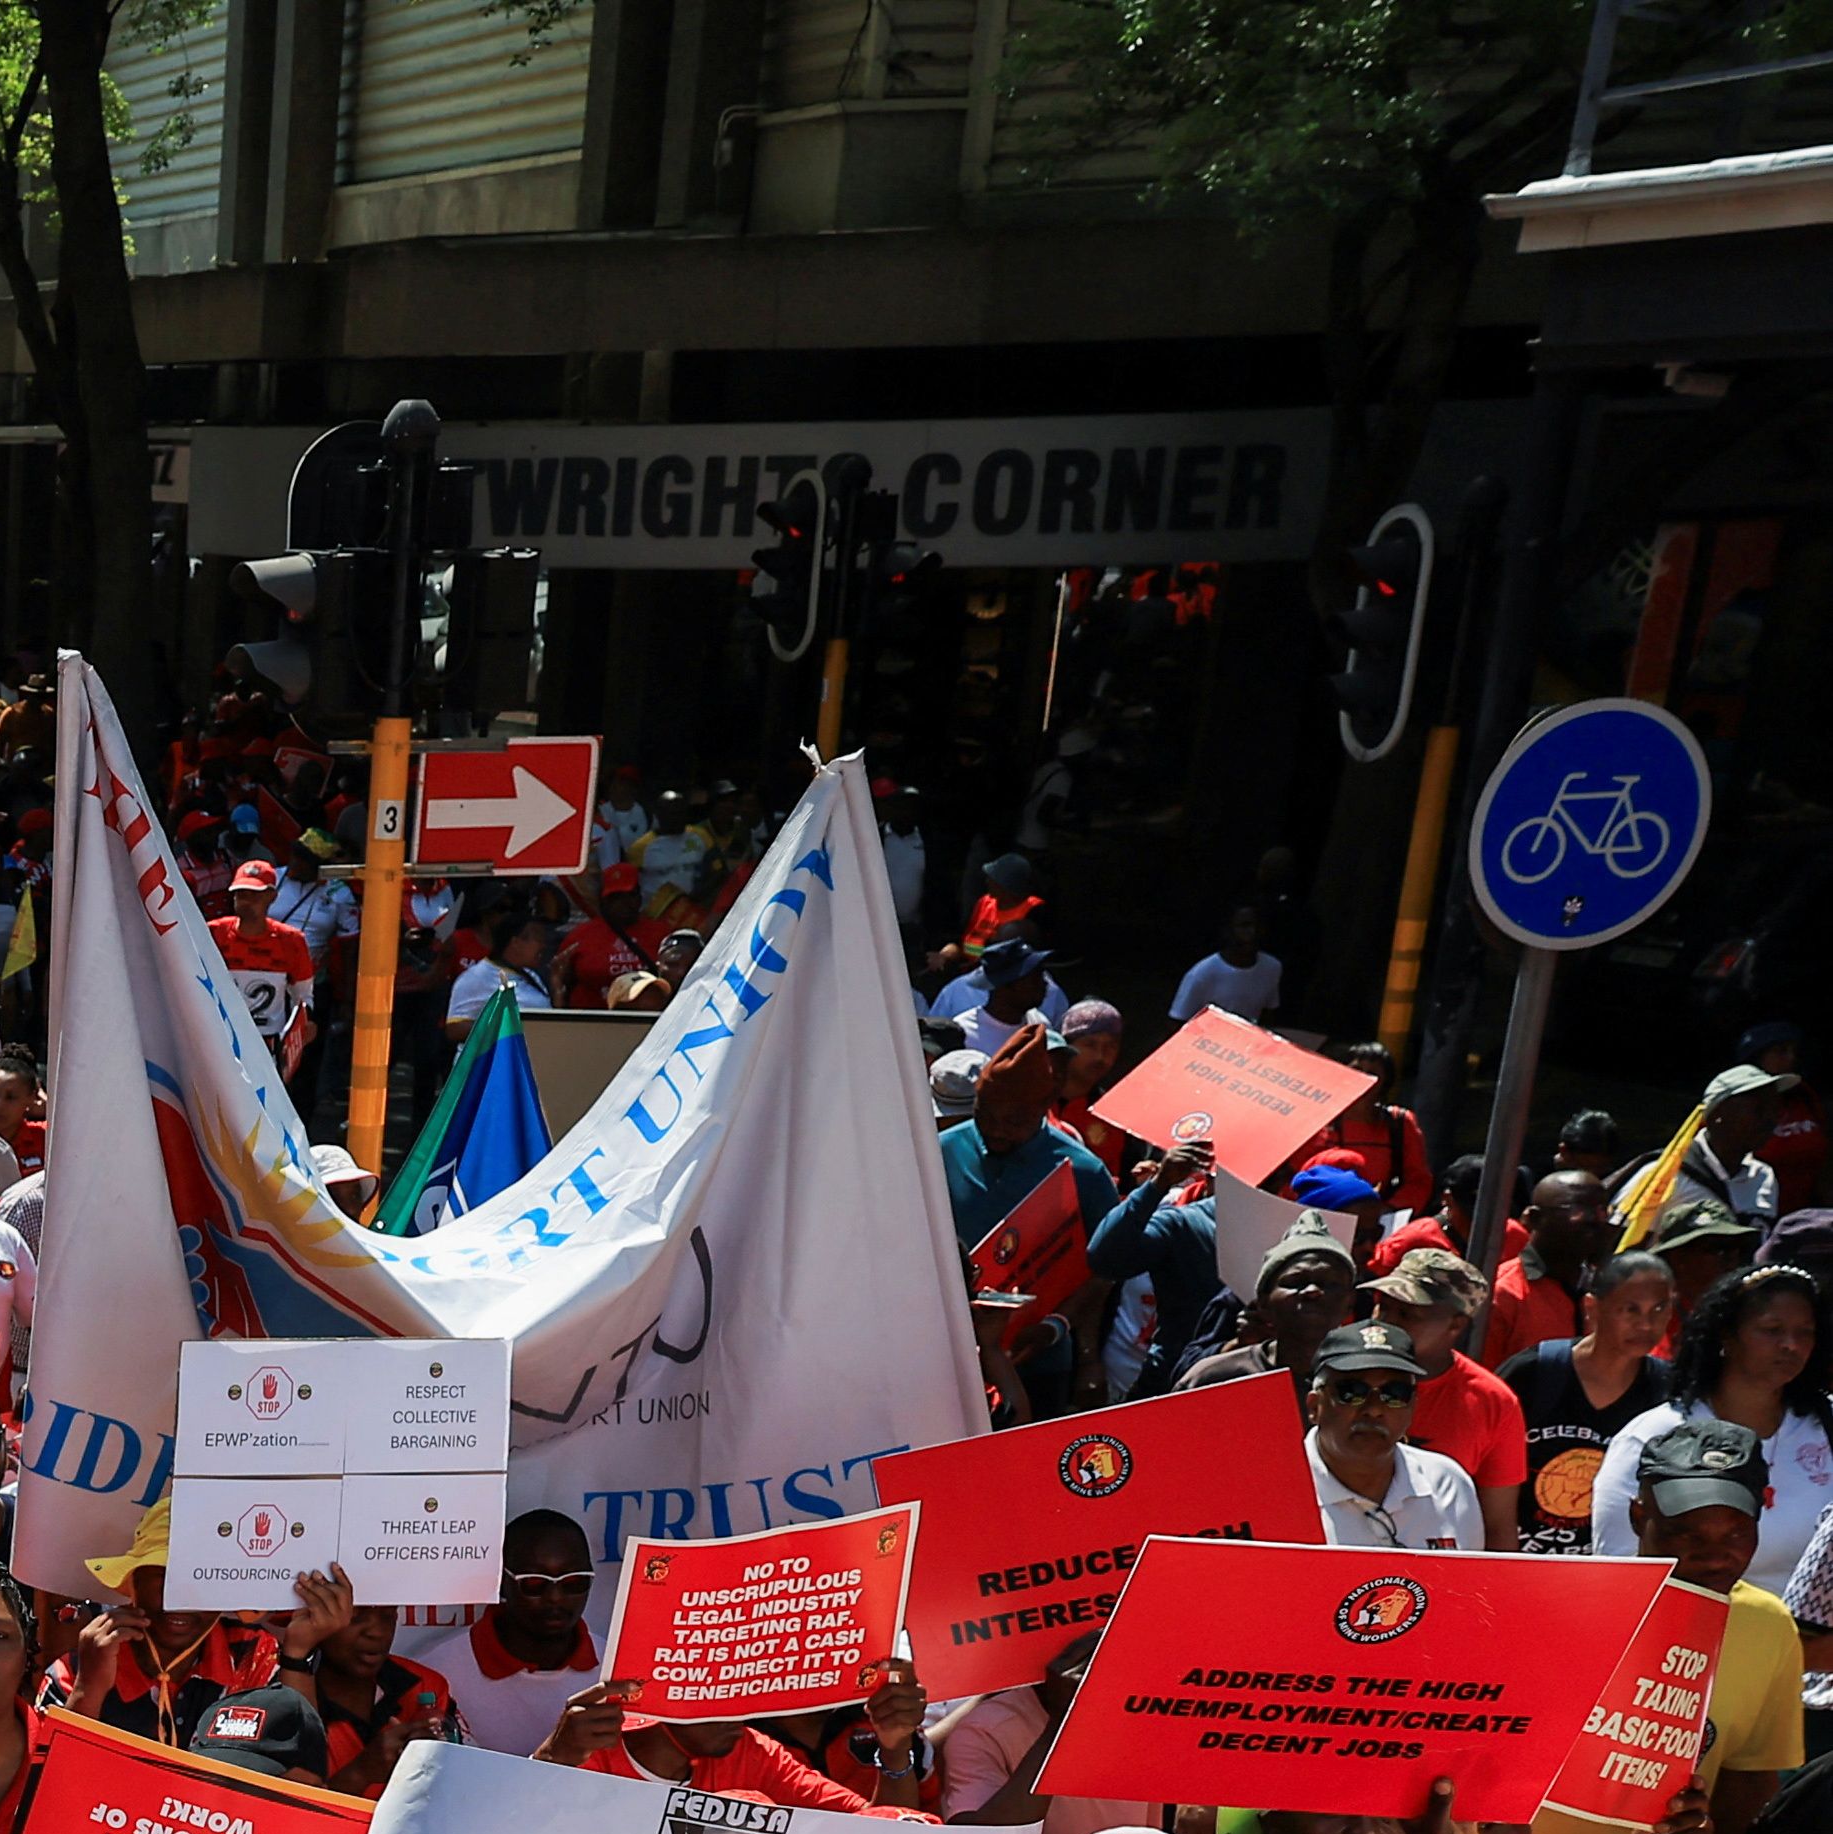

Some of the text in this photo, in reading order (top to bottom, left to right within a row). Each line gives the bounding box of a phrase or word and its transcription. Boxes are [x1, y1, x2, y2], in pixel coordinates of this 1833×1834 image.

[901, 447, 1287, 539] CORNER
[383, 806, 398, 833] 3
[257, 1385, 466, 1414] STOP RESPECT
[392, 1410, 477, 1424] COLLECTIVE
[390, 1434, 477, 1449] BARGAINING
[381, 1520, 477, 1535] THREAT LEAP
[248, 1538, 490, 1560] STOP OFFICERS FAIRLY
[742, 1556, 811, 1583] NO TO
[977, 1543, 1138, 1597] REDUCE
[680, 1569, 863, 1608] UNSCRUPULOUS
[672, 1588, 864, 1626] LEGAL INDUSTRY
[653, 1627, 866, 1663] RAF IS NOT CASH
[673, 1610, 855, 1645] TARGETING RAF.
[652, 1648, 861, 1685] COW, DIRECT IT TO
[1661, 1644, 1709, 1681] STOP
[666, 1669, 842, 1701] BENEFICIARIES!
[1179, 1667, 1506, 1702] ADDRESS THE HIGH
[1631, 1676, 1702, 1721] TAXING
[1122, 1694, 1533, 1735] UNEMPLOYMENT/CREATE
[1582, 1704, 1700, 1760] BASIC FOOD
[1196, 1731, 1425, 1760] DECENT JOBS
[1598, 1750, 1669, 1790] ITEMS!
[89, 1802, 129, 1829] OF
[666, 1789, 792, 1834] FEDUSA
